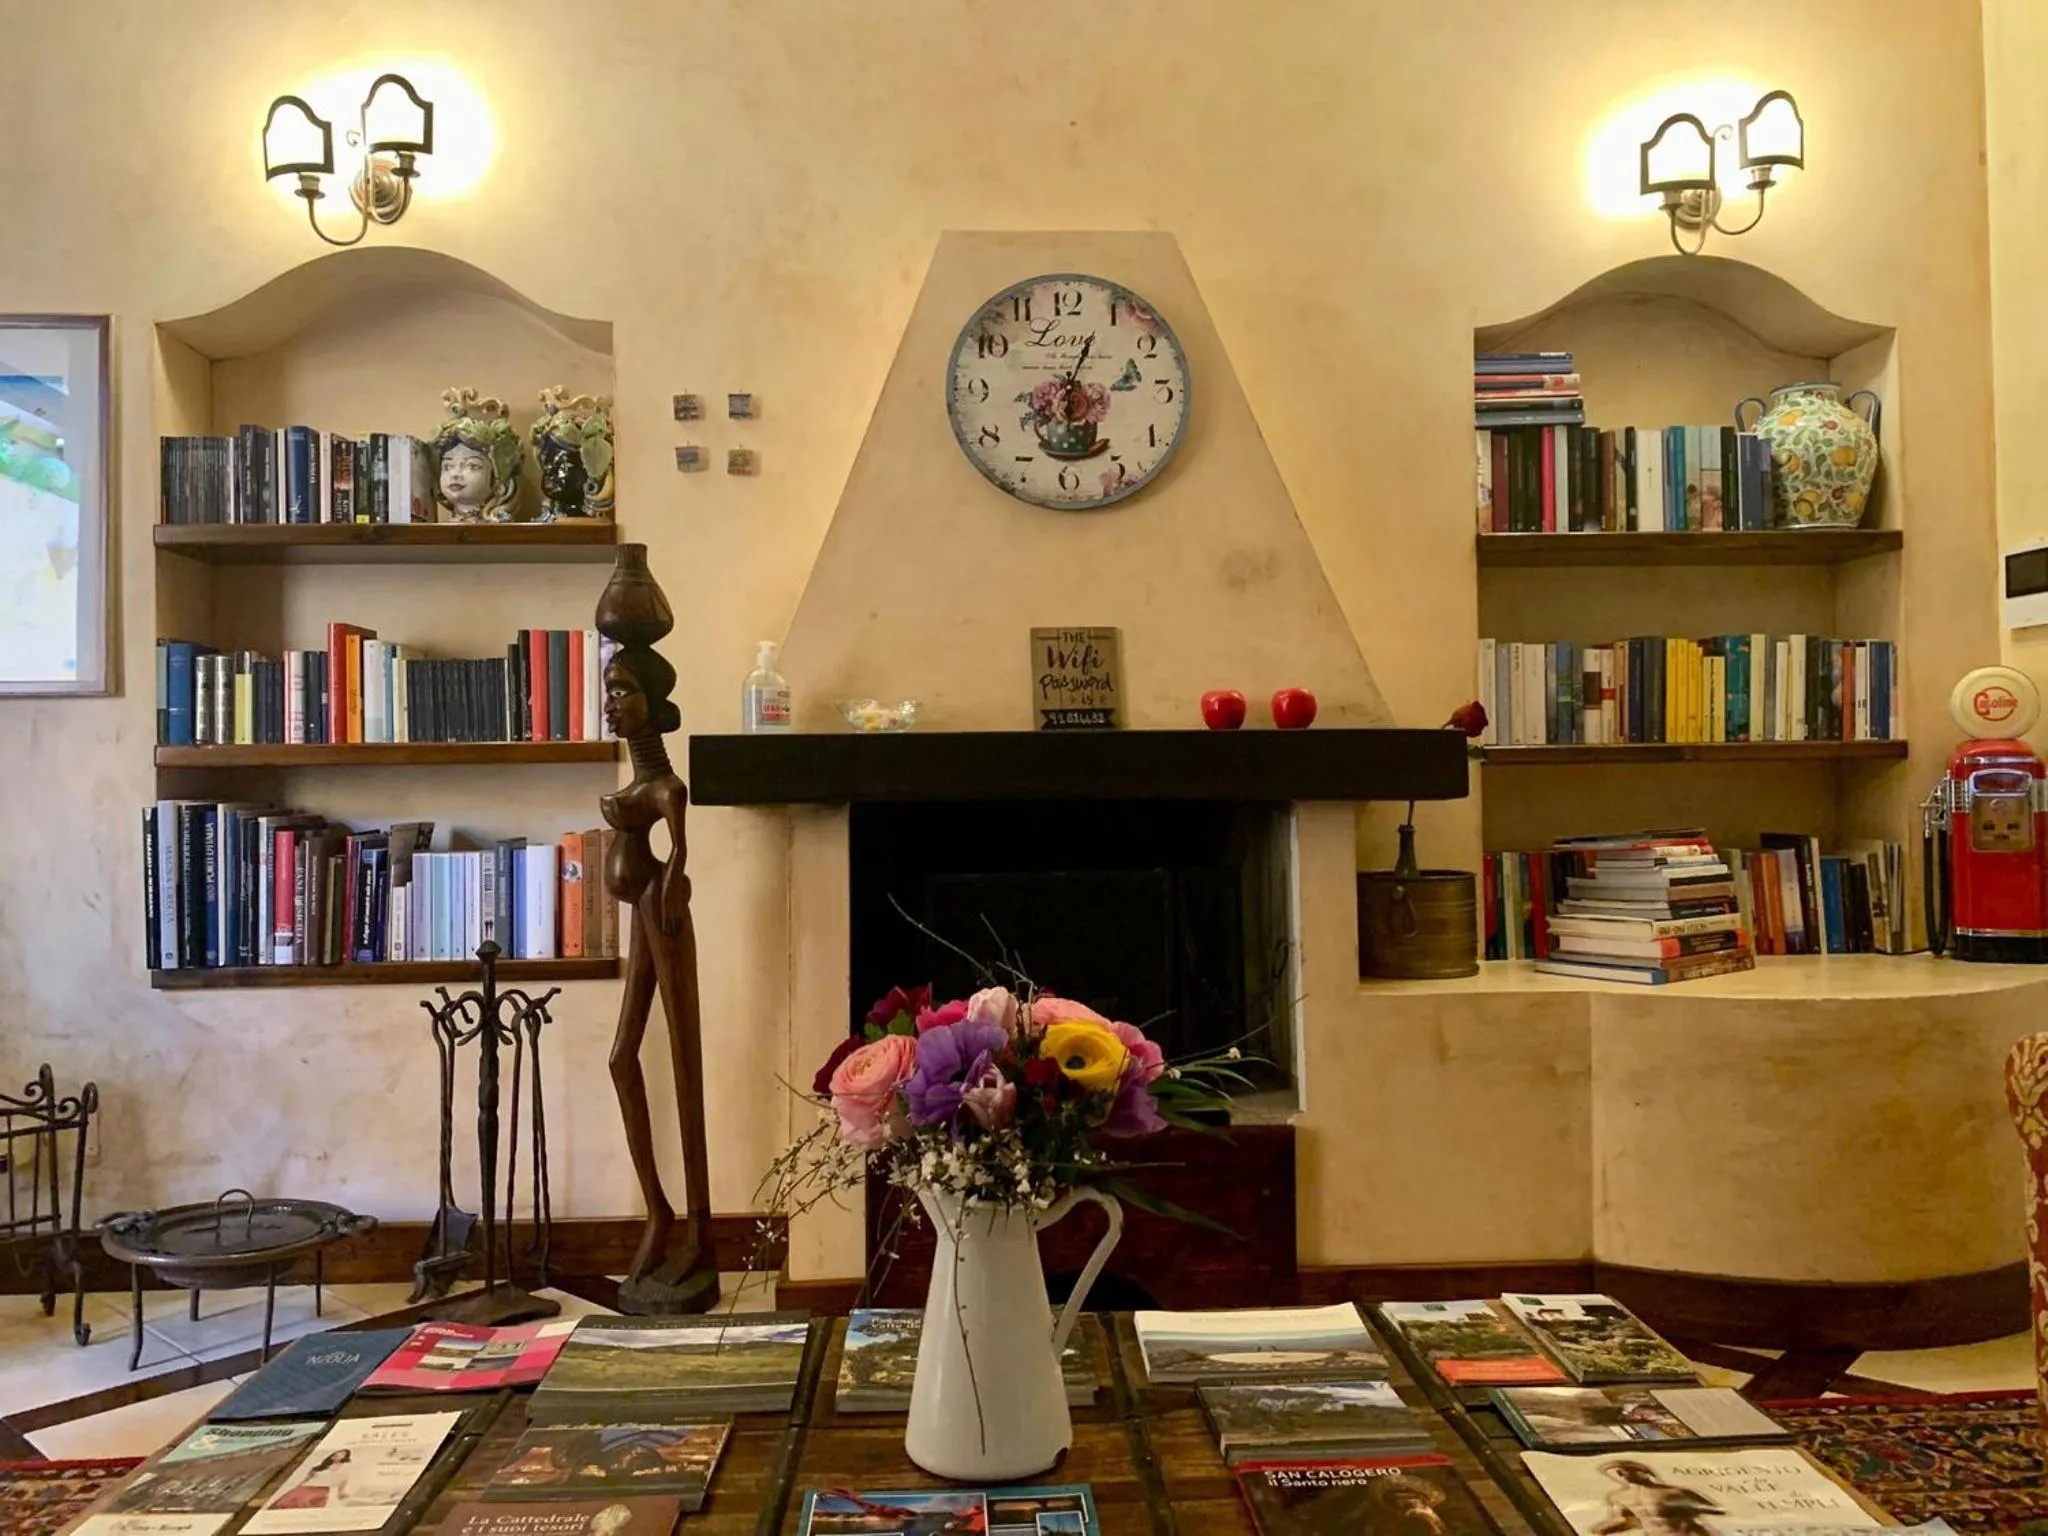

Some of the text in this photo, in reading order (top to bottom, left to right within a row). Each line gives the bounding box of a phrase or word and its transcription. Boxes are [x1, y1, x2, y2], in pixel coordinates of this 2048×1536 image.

[1014, 297, 1031, 322] 11
[1054, 290, 1083, 316] 12
[1110, 302, 1117, 326] 1
[1024, 317, 1096, 348] Love
[978, 334, 1009, 359] 10
[1136, 334, 1157, 359] 2
[968, 378, 990, 403] 9
[1154, 379, 1174, 404] 3
[978, 424, 1001, 449] 8
[1015, 456, 1034, 483] 7
[1058, 465, 1081, 492] 6
[1109, 454, 1126, 482] 5
[1046, 644, 1105, 676] Wifi
[1264, 1470, 1301, 1480] SAN
[1306, 1467, 1402, 1479] CALOGERO
[1281, 1478, 1328, 1487] Santo
[1331, 1477, 1367, 1487] nero
[469, 1513, 591, 1525] La Cattedrale
